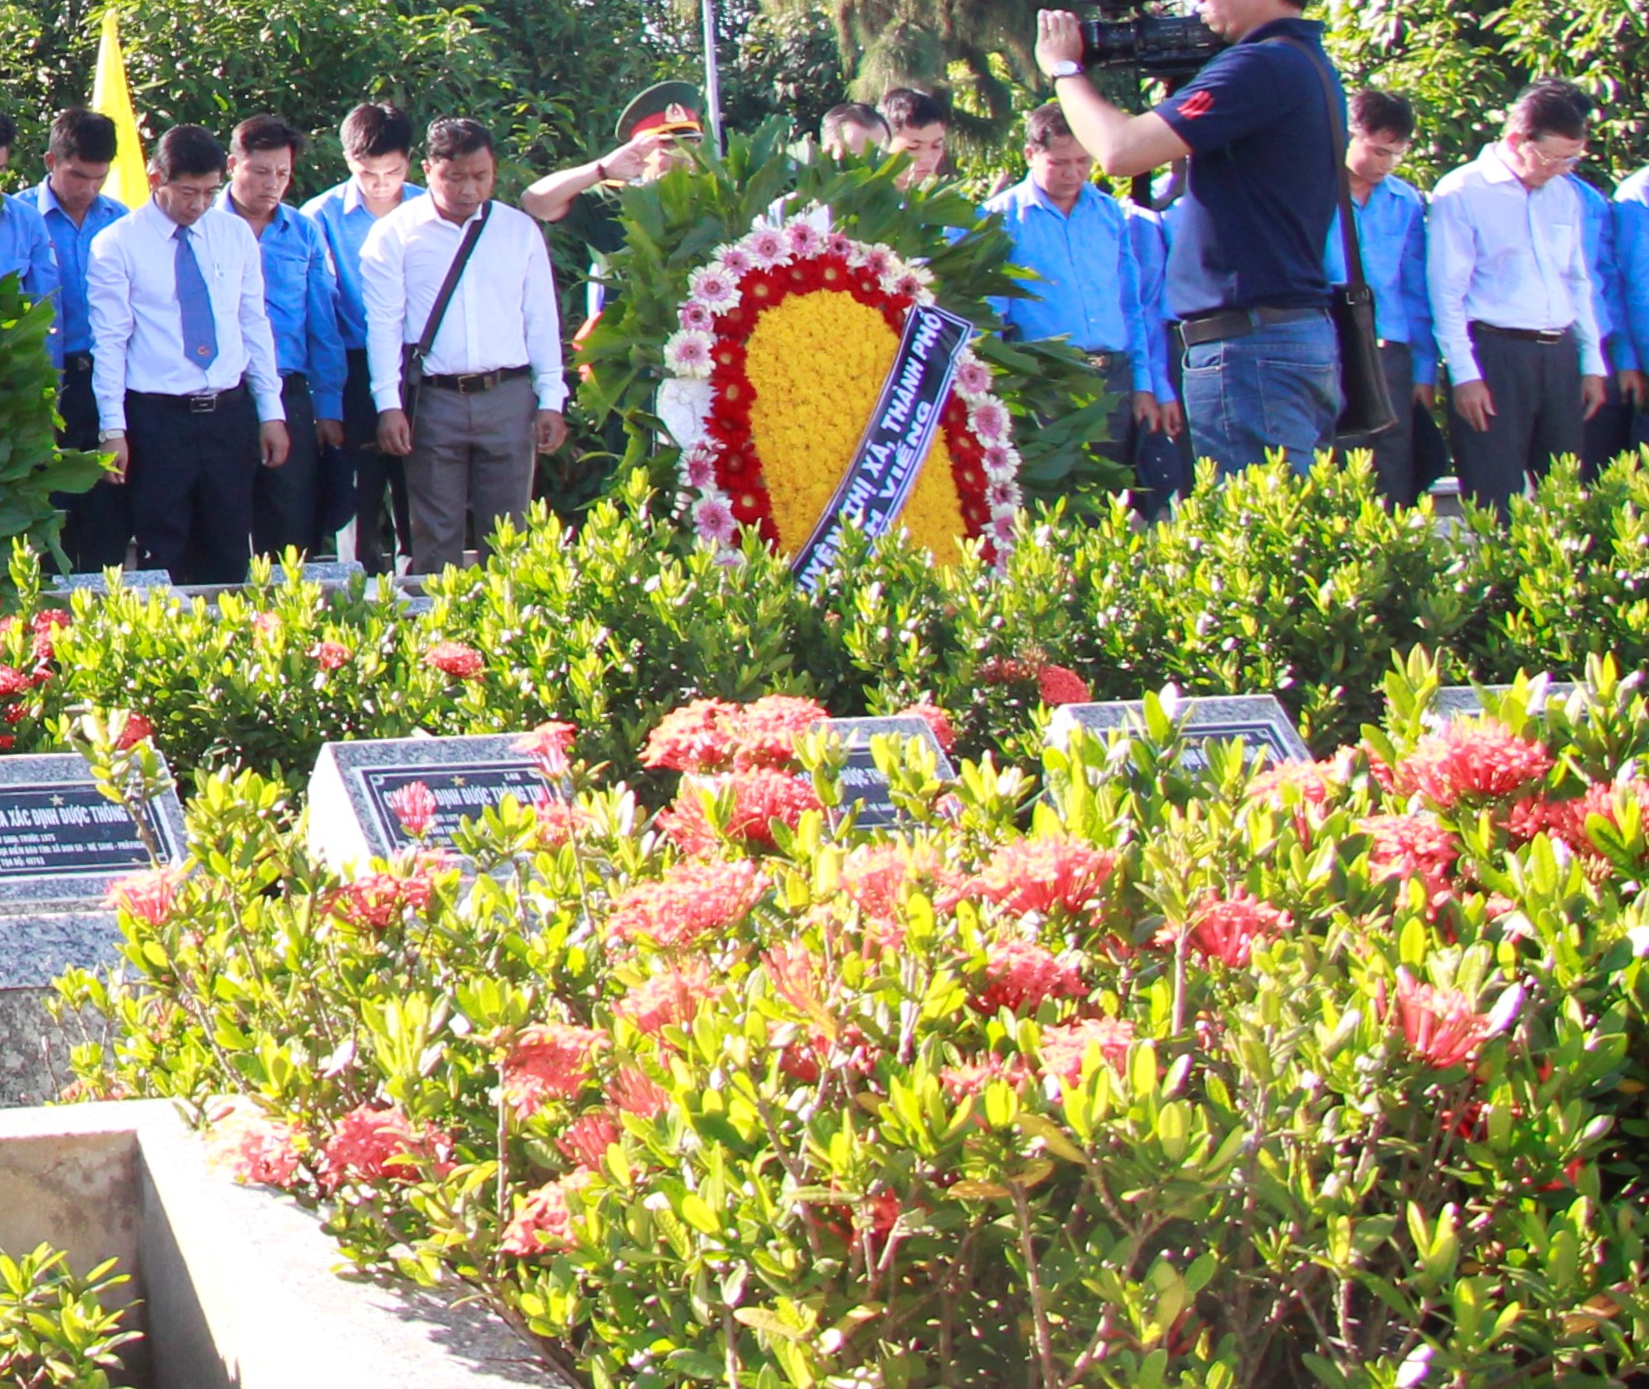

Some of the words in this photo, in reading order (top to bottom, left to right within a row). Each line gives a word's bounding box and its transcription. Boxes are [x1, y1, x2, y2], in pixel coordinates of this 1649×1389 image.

[861, 439, 897, 478] XÃ,
[881, 359, 924, 433] THÀNH
[911, 310, 943, 362] PHỐ
[878, 400, 932, 499] VIẾNG
[7, 806, 33, 827] XÁC
[88, 801, 129, 823] THÔNG
